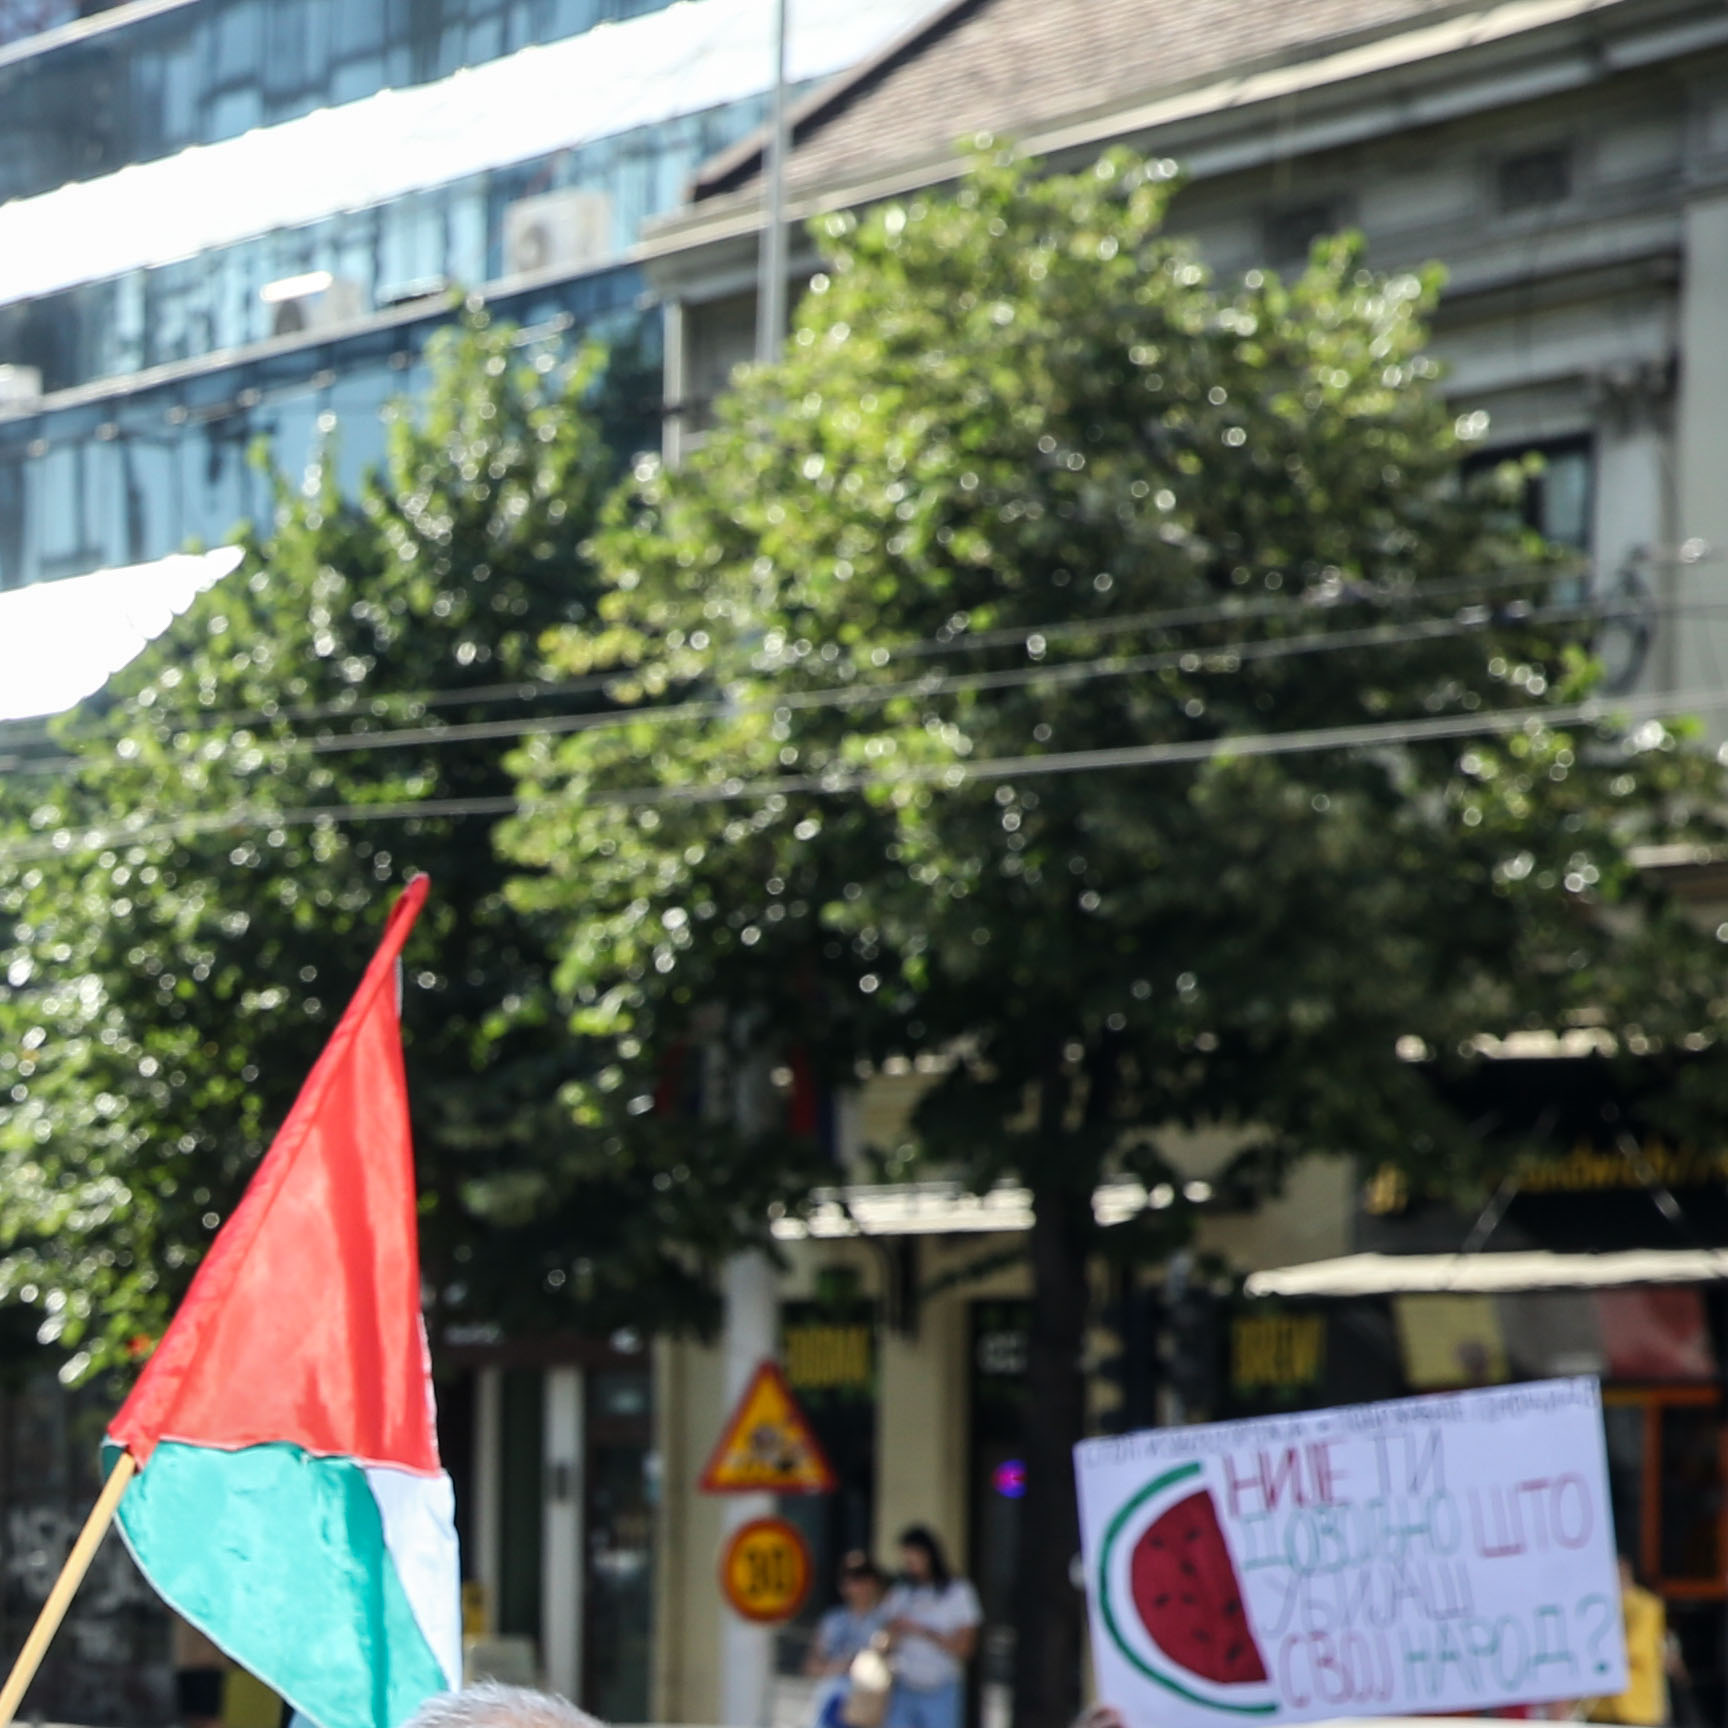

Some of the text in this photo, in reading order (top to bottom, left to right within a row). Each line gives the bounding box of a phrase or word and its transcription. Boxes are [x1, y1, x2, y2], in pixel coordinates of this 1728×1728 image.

[1370, 1428, 1446, 1503] ТИ
[1470, 1472, 1594, 1558] ШТО
[1278, 1631, 1395, 1709] СВОЈ
